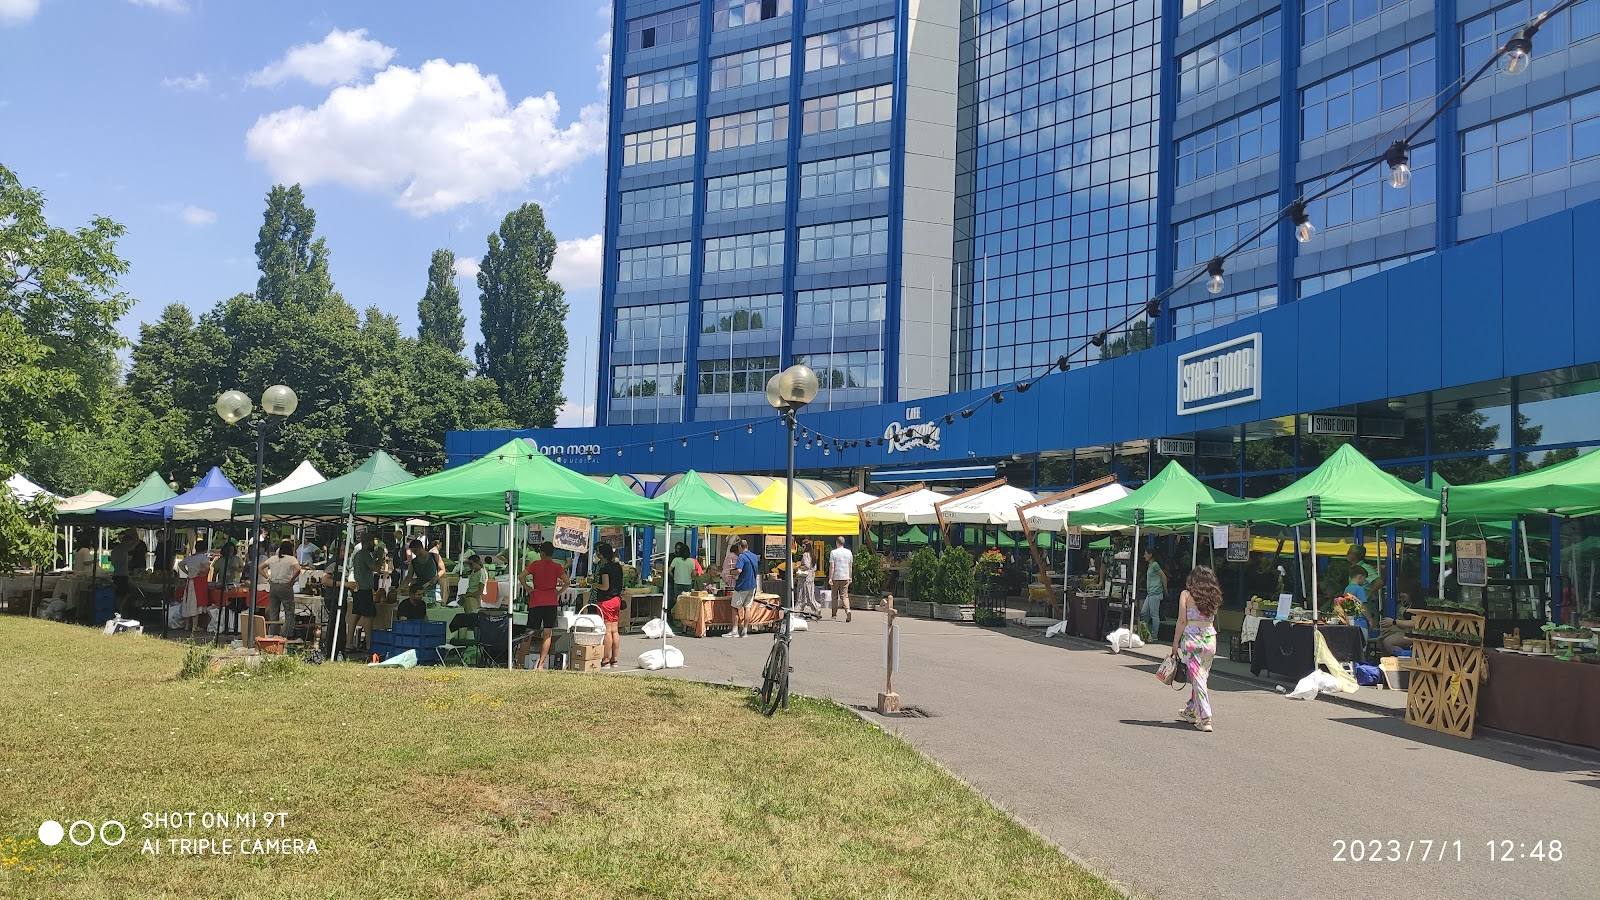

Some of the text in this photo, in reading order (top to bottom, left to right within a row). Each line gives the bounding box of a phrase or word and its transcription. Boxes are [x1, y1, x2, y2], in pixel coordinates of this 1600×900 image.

[1184, 348, 1253, 402] STAGE DOOR
[1316, 417, 1335, 431] STAGE
